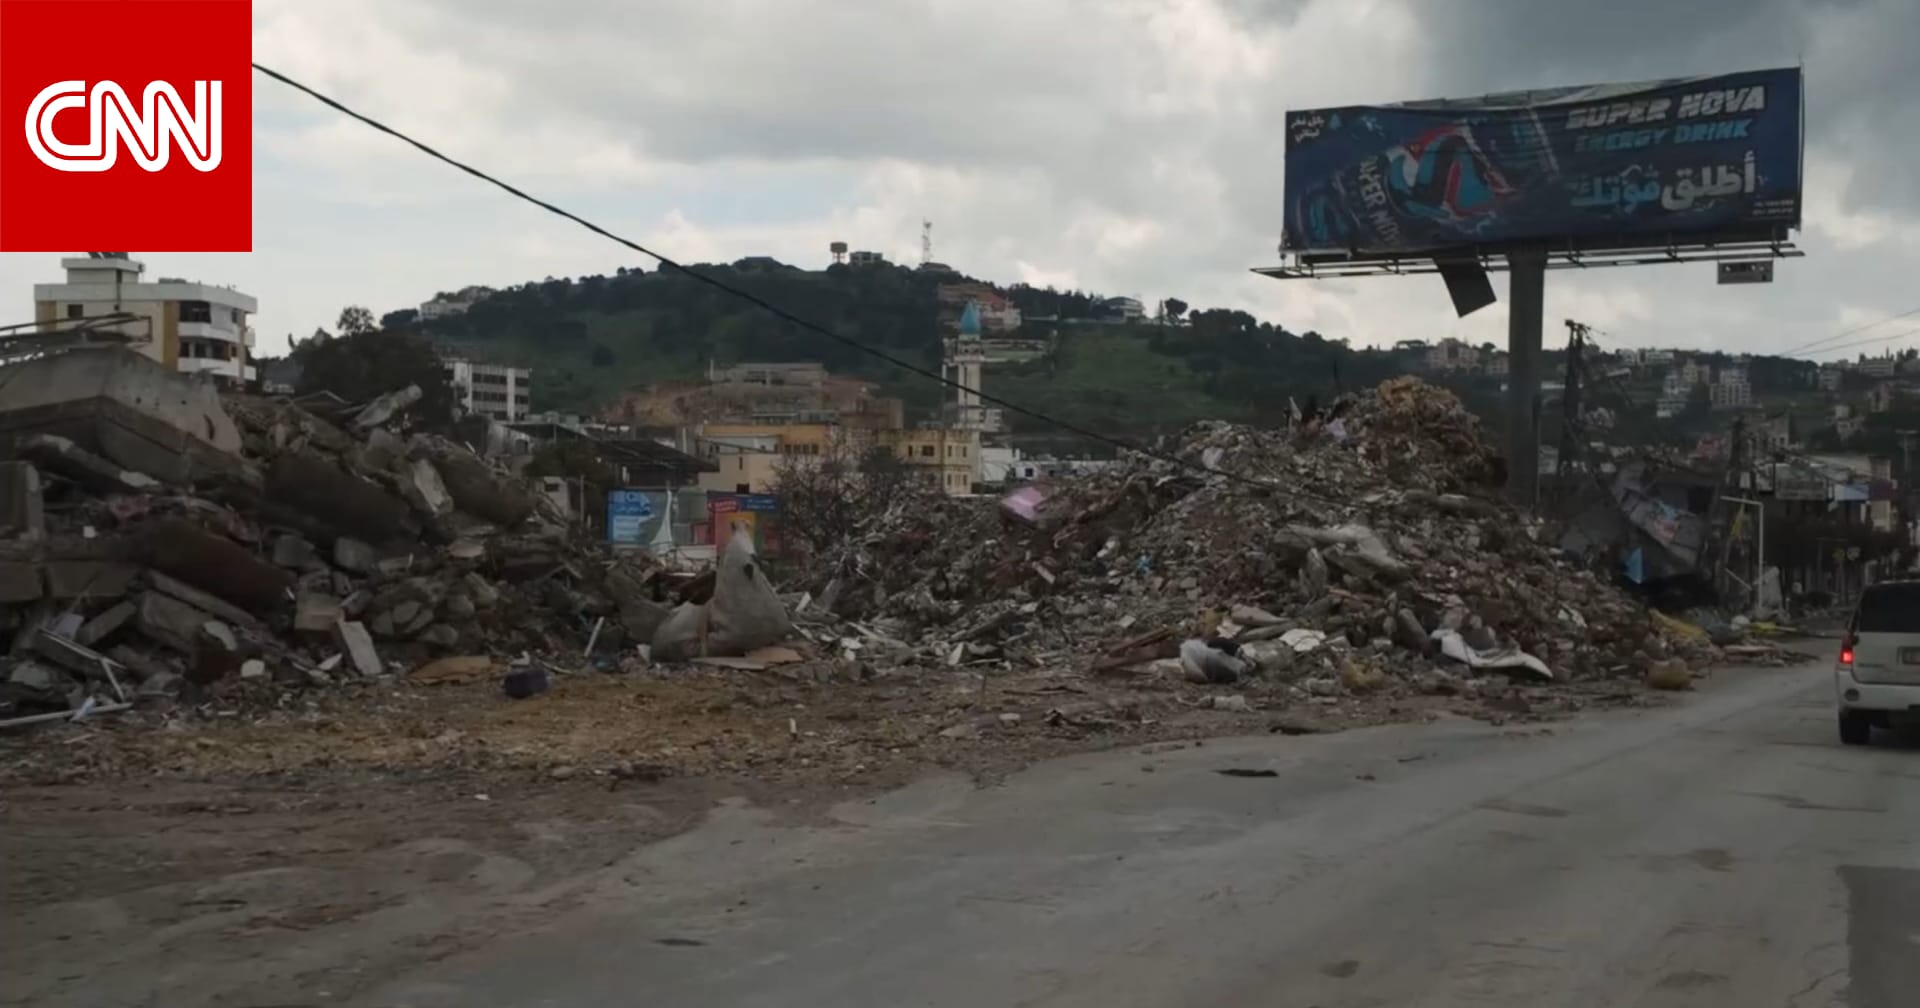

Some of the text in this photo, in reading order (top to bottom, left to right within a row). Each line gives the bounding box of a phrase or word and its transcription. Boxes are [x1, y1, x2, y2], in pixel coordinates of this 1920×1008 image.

[1566, 85, 1765, 129] SUPER NOVA
[1575, 118, 1752, 152] ENERGY DRINK
